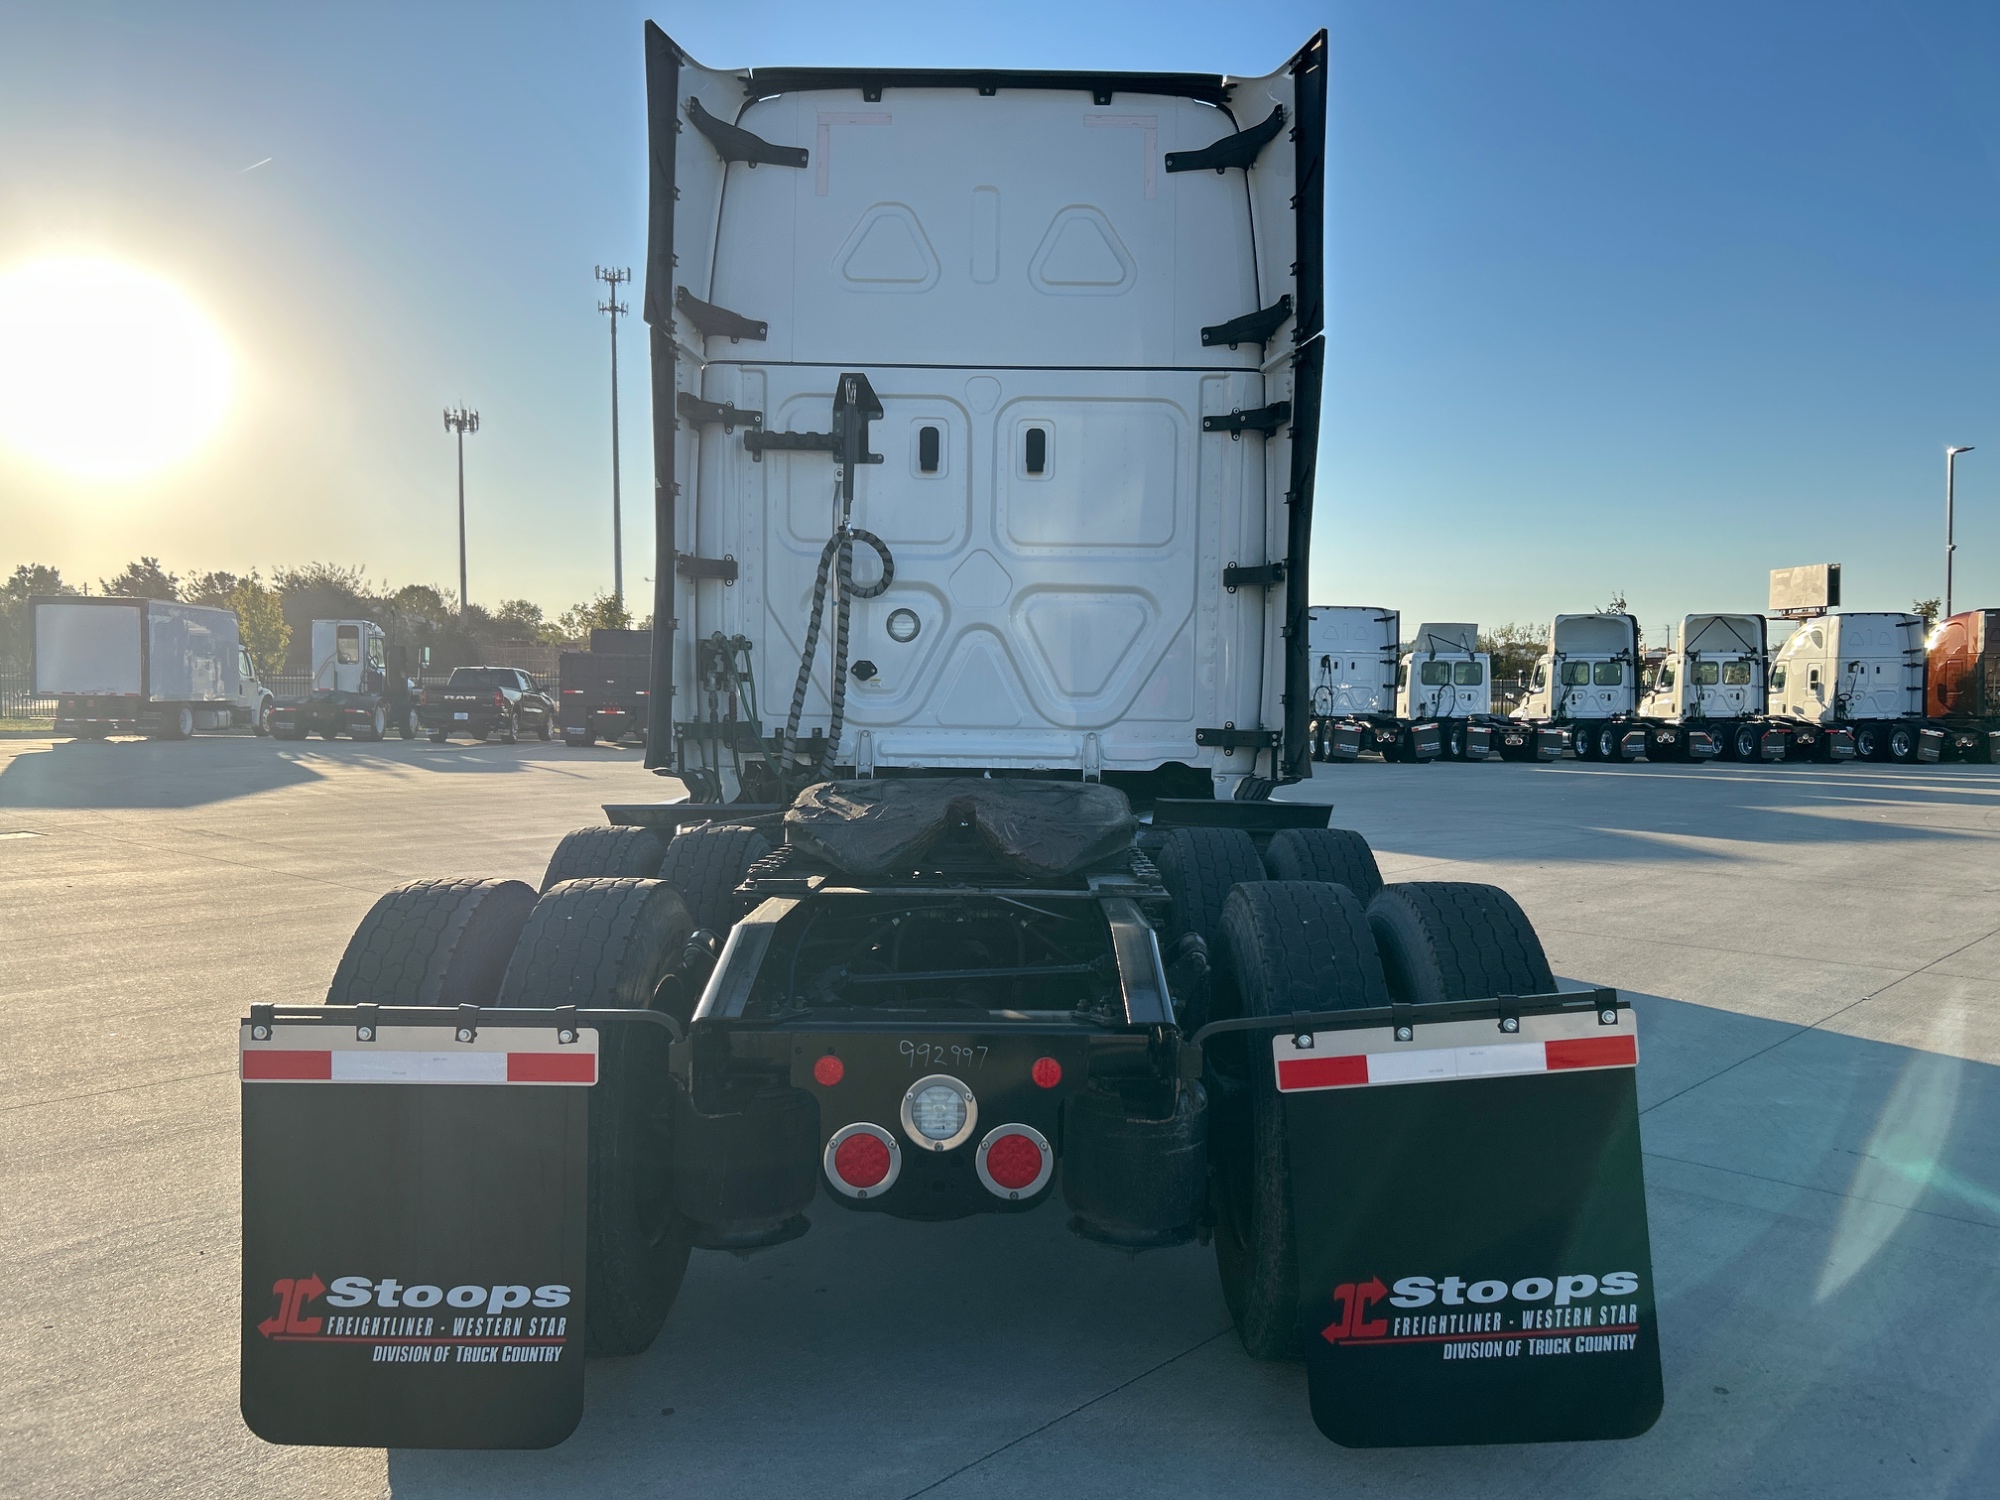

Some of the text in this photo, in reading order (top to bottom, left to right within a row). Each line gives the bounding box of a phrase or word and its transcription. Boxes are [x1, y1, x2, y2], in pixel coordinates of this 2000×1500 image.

[899, 1040, 988, 1069] 992997
[326, 1276, 571, 1314] Stoops
[1389, 1271, 1639, 1308] Stoops
[326, 1316, 433, 1336] FREIGHTLINER
[452, 1316, 522, 1337] WESTERN
[528, 1316, 567, 1336] STAR
[1393, 1312, 1502, 1336] FREIGHTLINER
[1522, 1306, 1592, 1330] WESTERN
[1599, 1304, 1638, 1325] STAR
[373, 1346, 563, 1363] DIVISION OF TRUCK COUNTRY
[1443, 1334, 1637, 1360] DIVISION OF TRUCK COUNTRY
